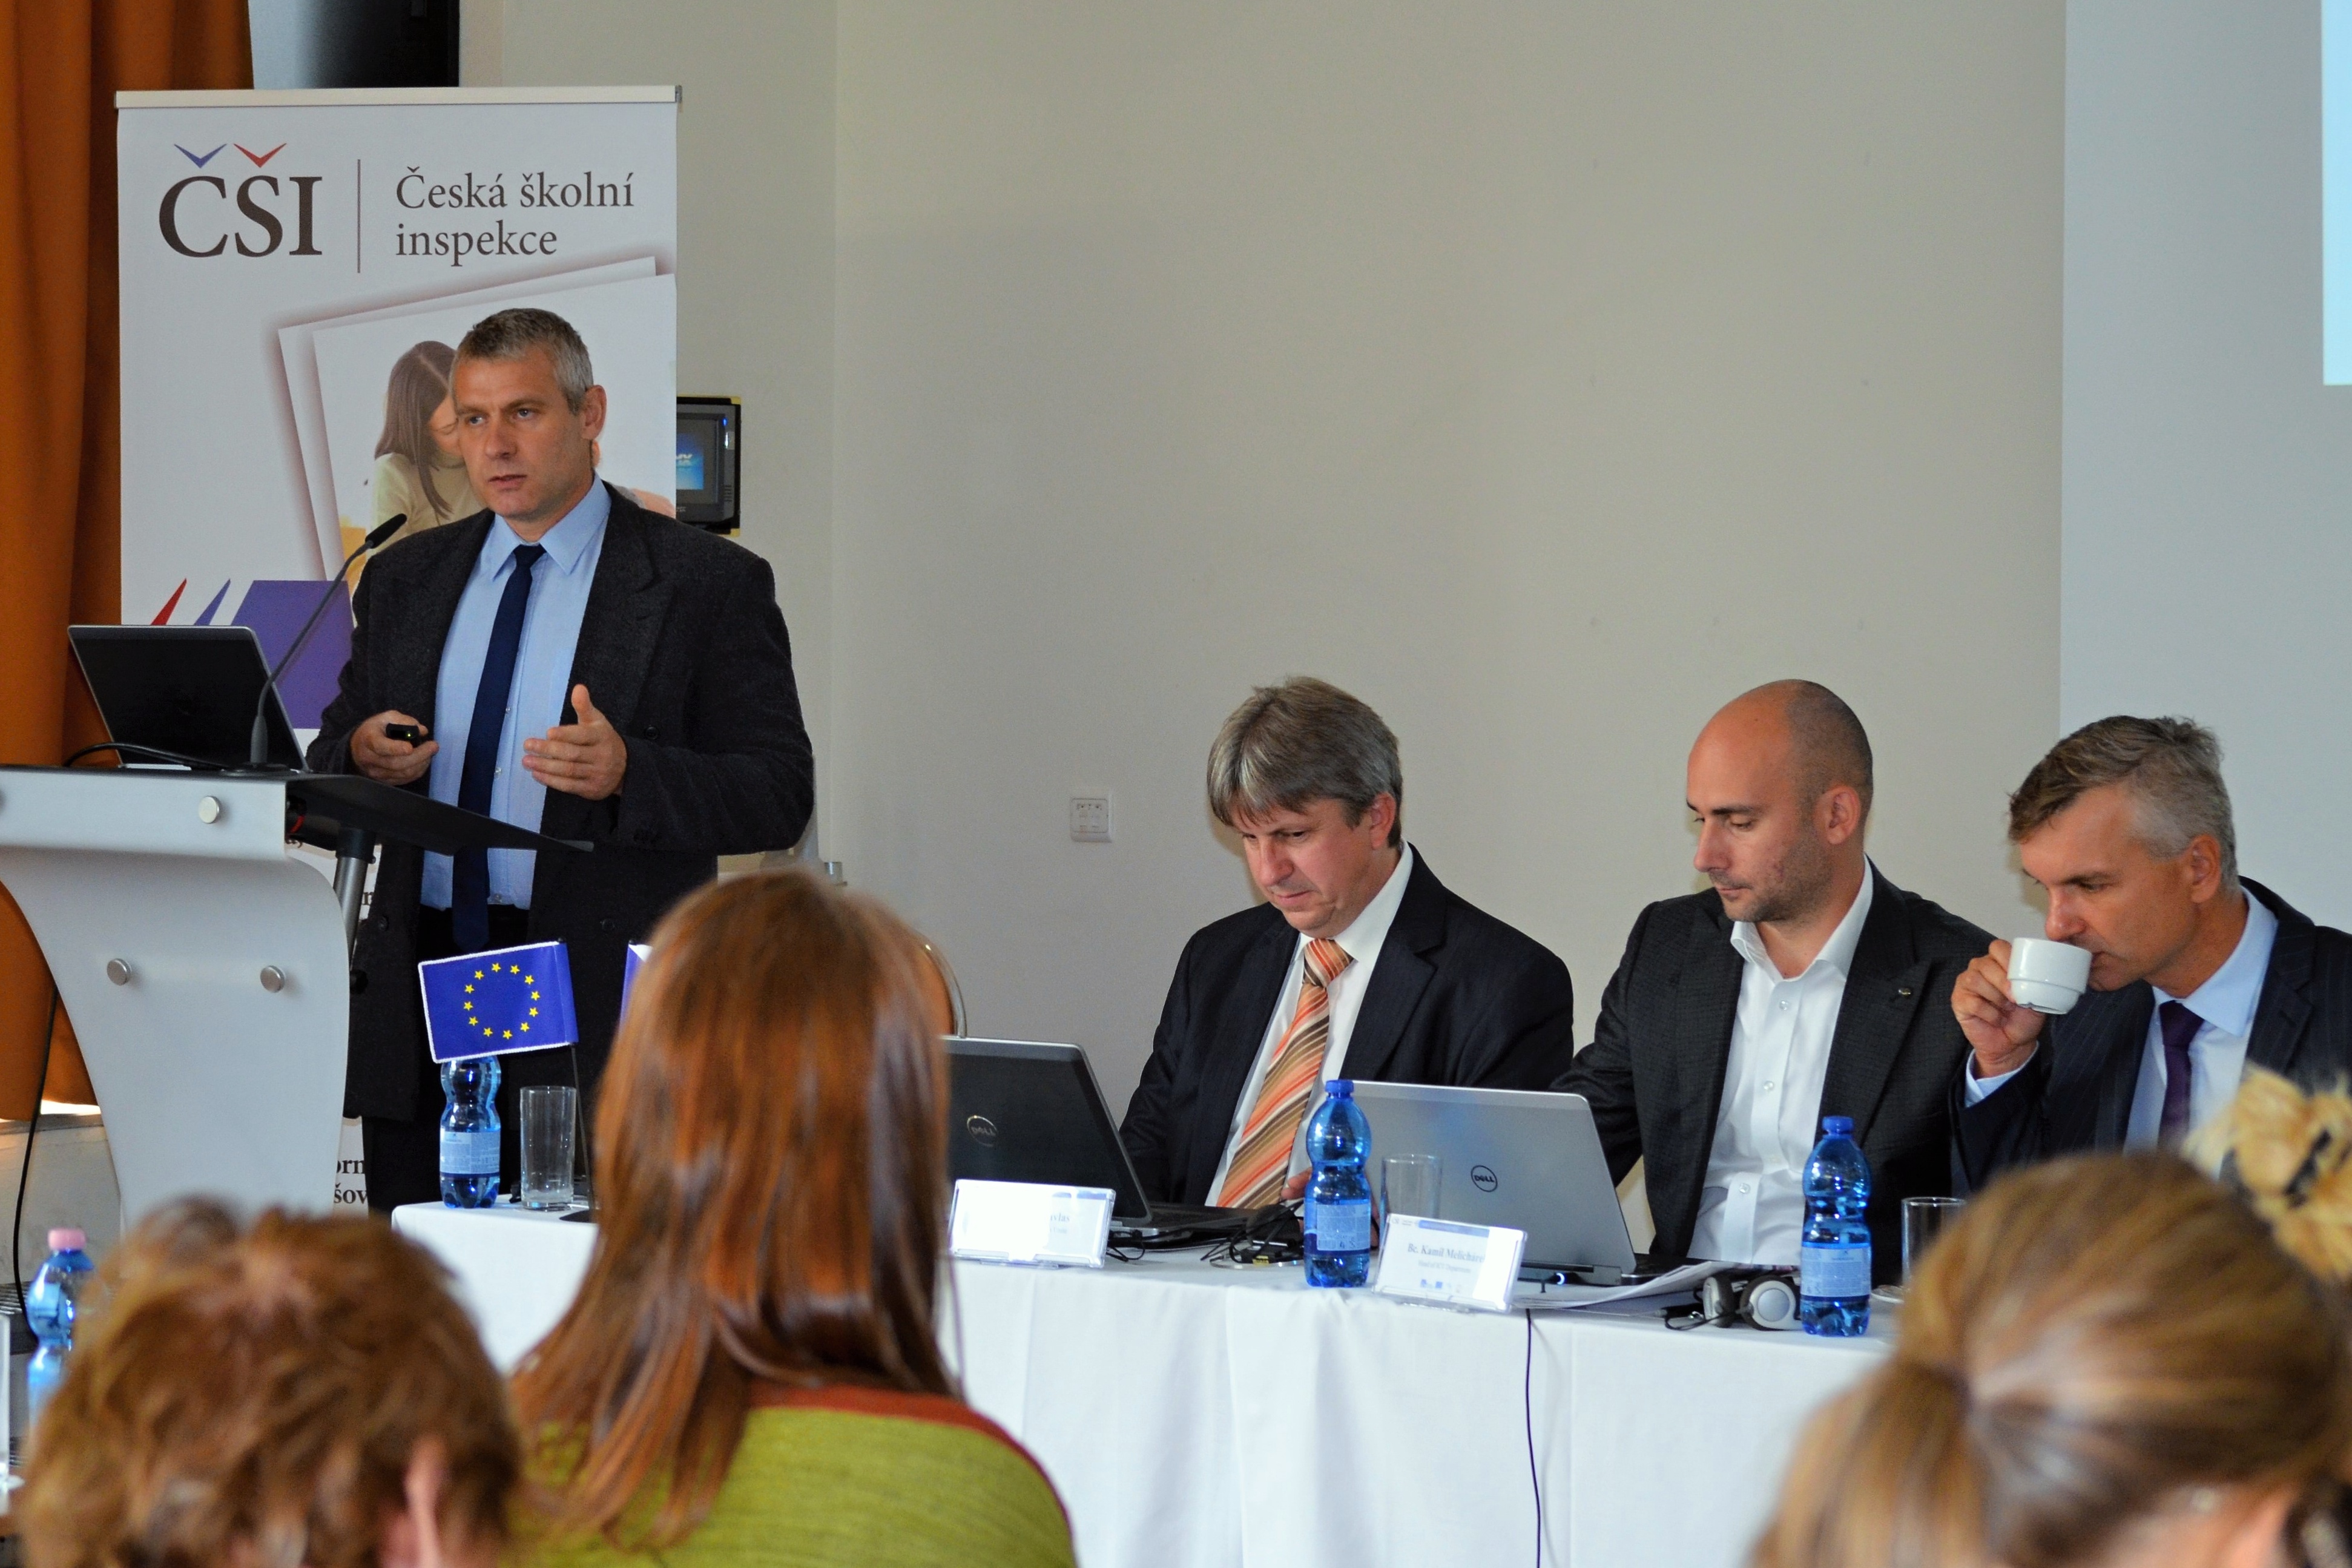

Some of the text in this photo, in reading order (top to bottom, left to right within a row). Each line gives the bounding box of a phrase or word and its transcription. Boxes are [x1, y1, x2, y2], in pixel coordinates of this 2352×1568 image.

[159, 143, 323, 259] ČŠI
[395, 166, 634, 209] Česká školní
[395, 219, 558, 267] inspekce
[1473, 1174, 1495, 1183] DELL
[1421, 1245, 1444, 1257] Kamil
